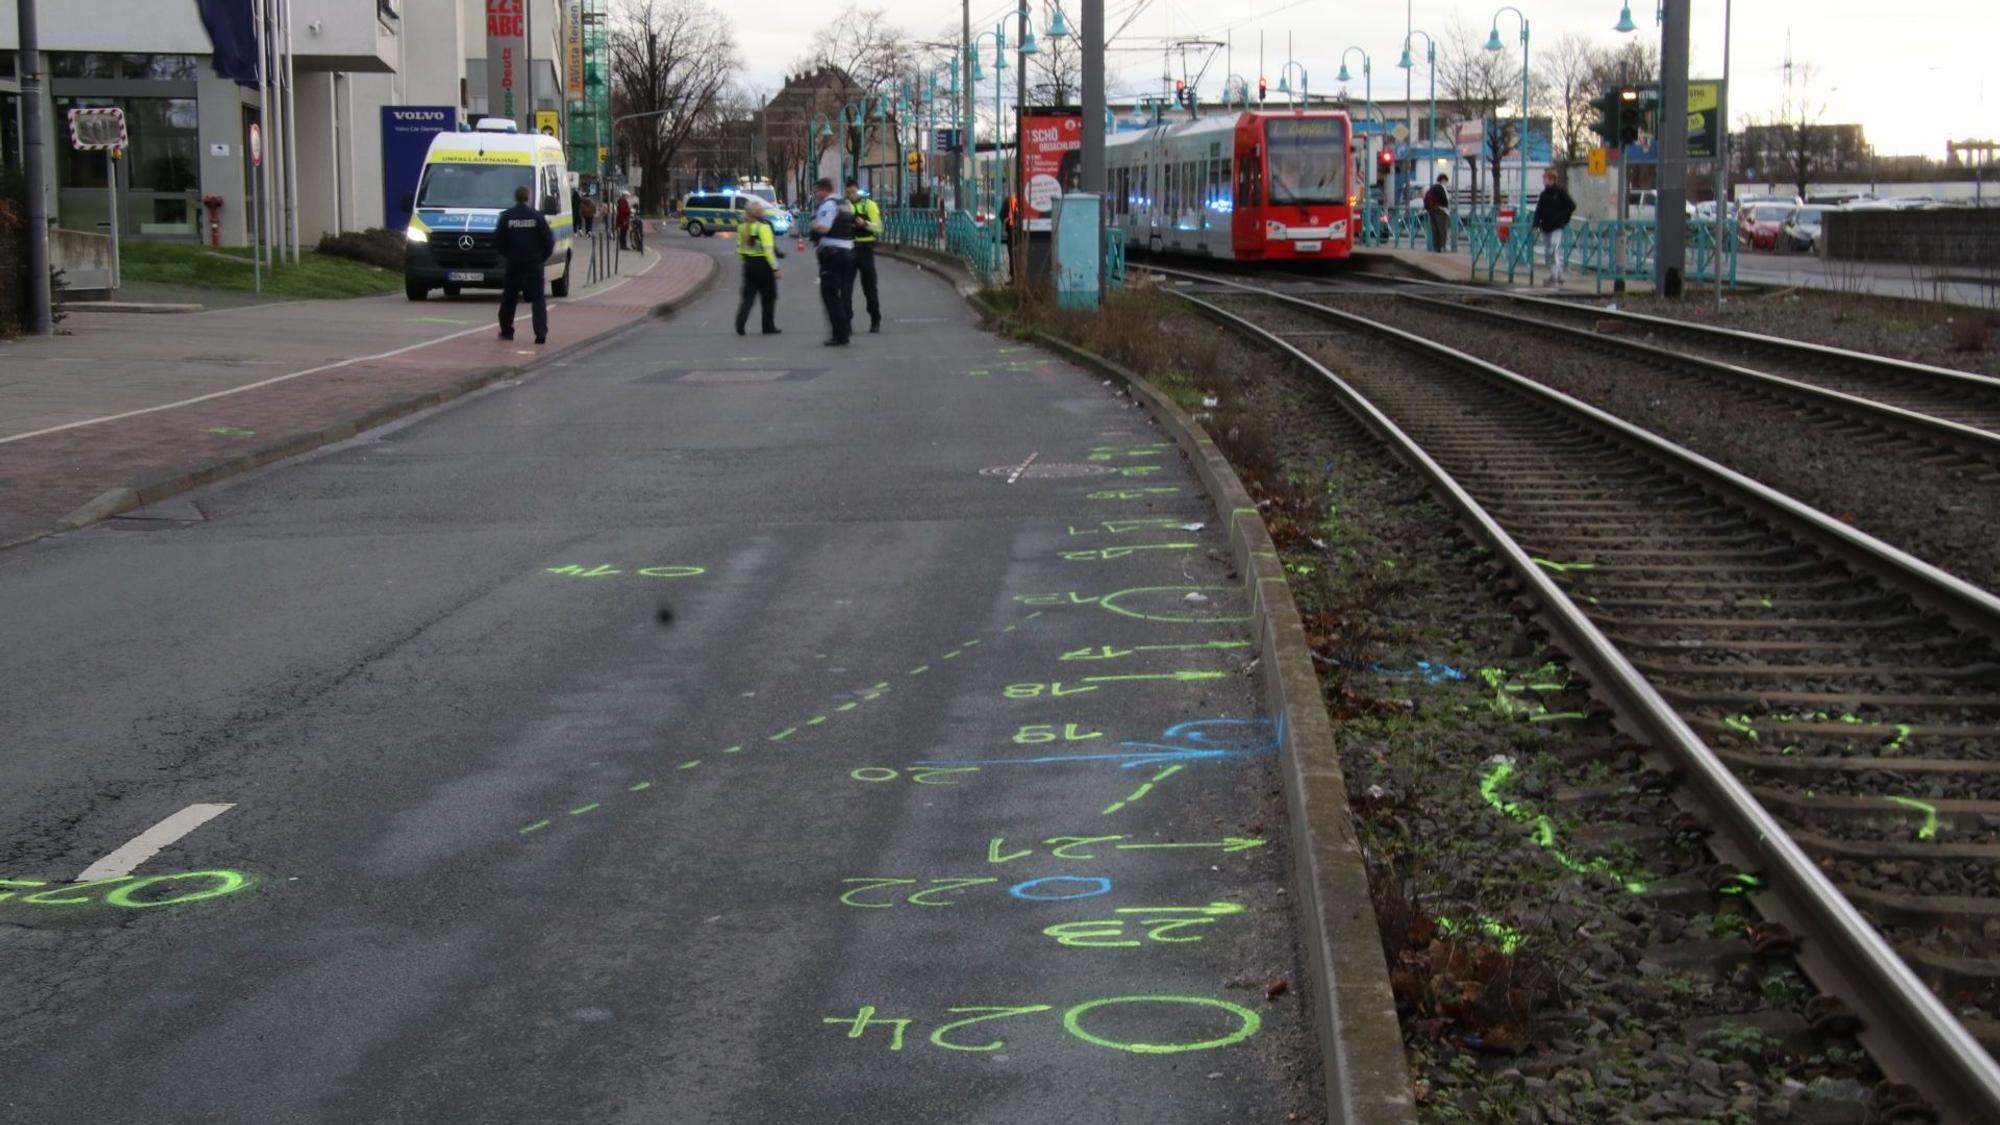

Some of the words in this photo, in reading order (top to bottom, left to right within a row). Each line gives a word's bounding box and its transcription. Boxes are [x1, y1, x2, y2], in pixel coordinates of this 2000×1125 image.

[487, 15, 523, 37] ABC
[569, 5, 579, 43] Reisen
[393, 112, 444, 120] VOLVO
[508, 219, 537, 228] POLIZEI
[1003, 682, 1099, 698] 18
[1012, 723, 1103, 744] 19
[851, 766, 981, 785] 20
[988, 834, 1125, 863] 21
[840, 876, 999, 908] 22
[1043, 917, 1216, 947] 23
[823, 1004, 1053, 1051] 24
